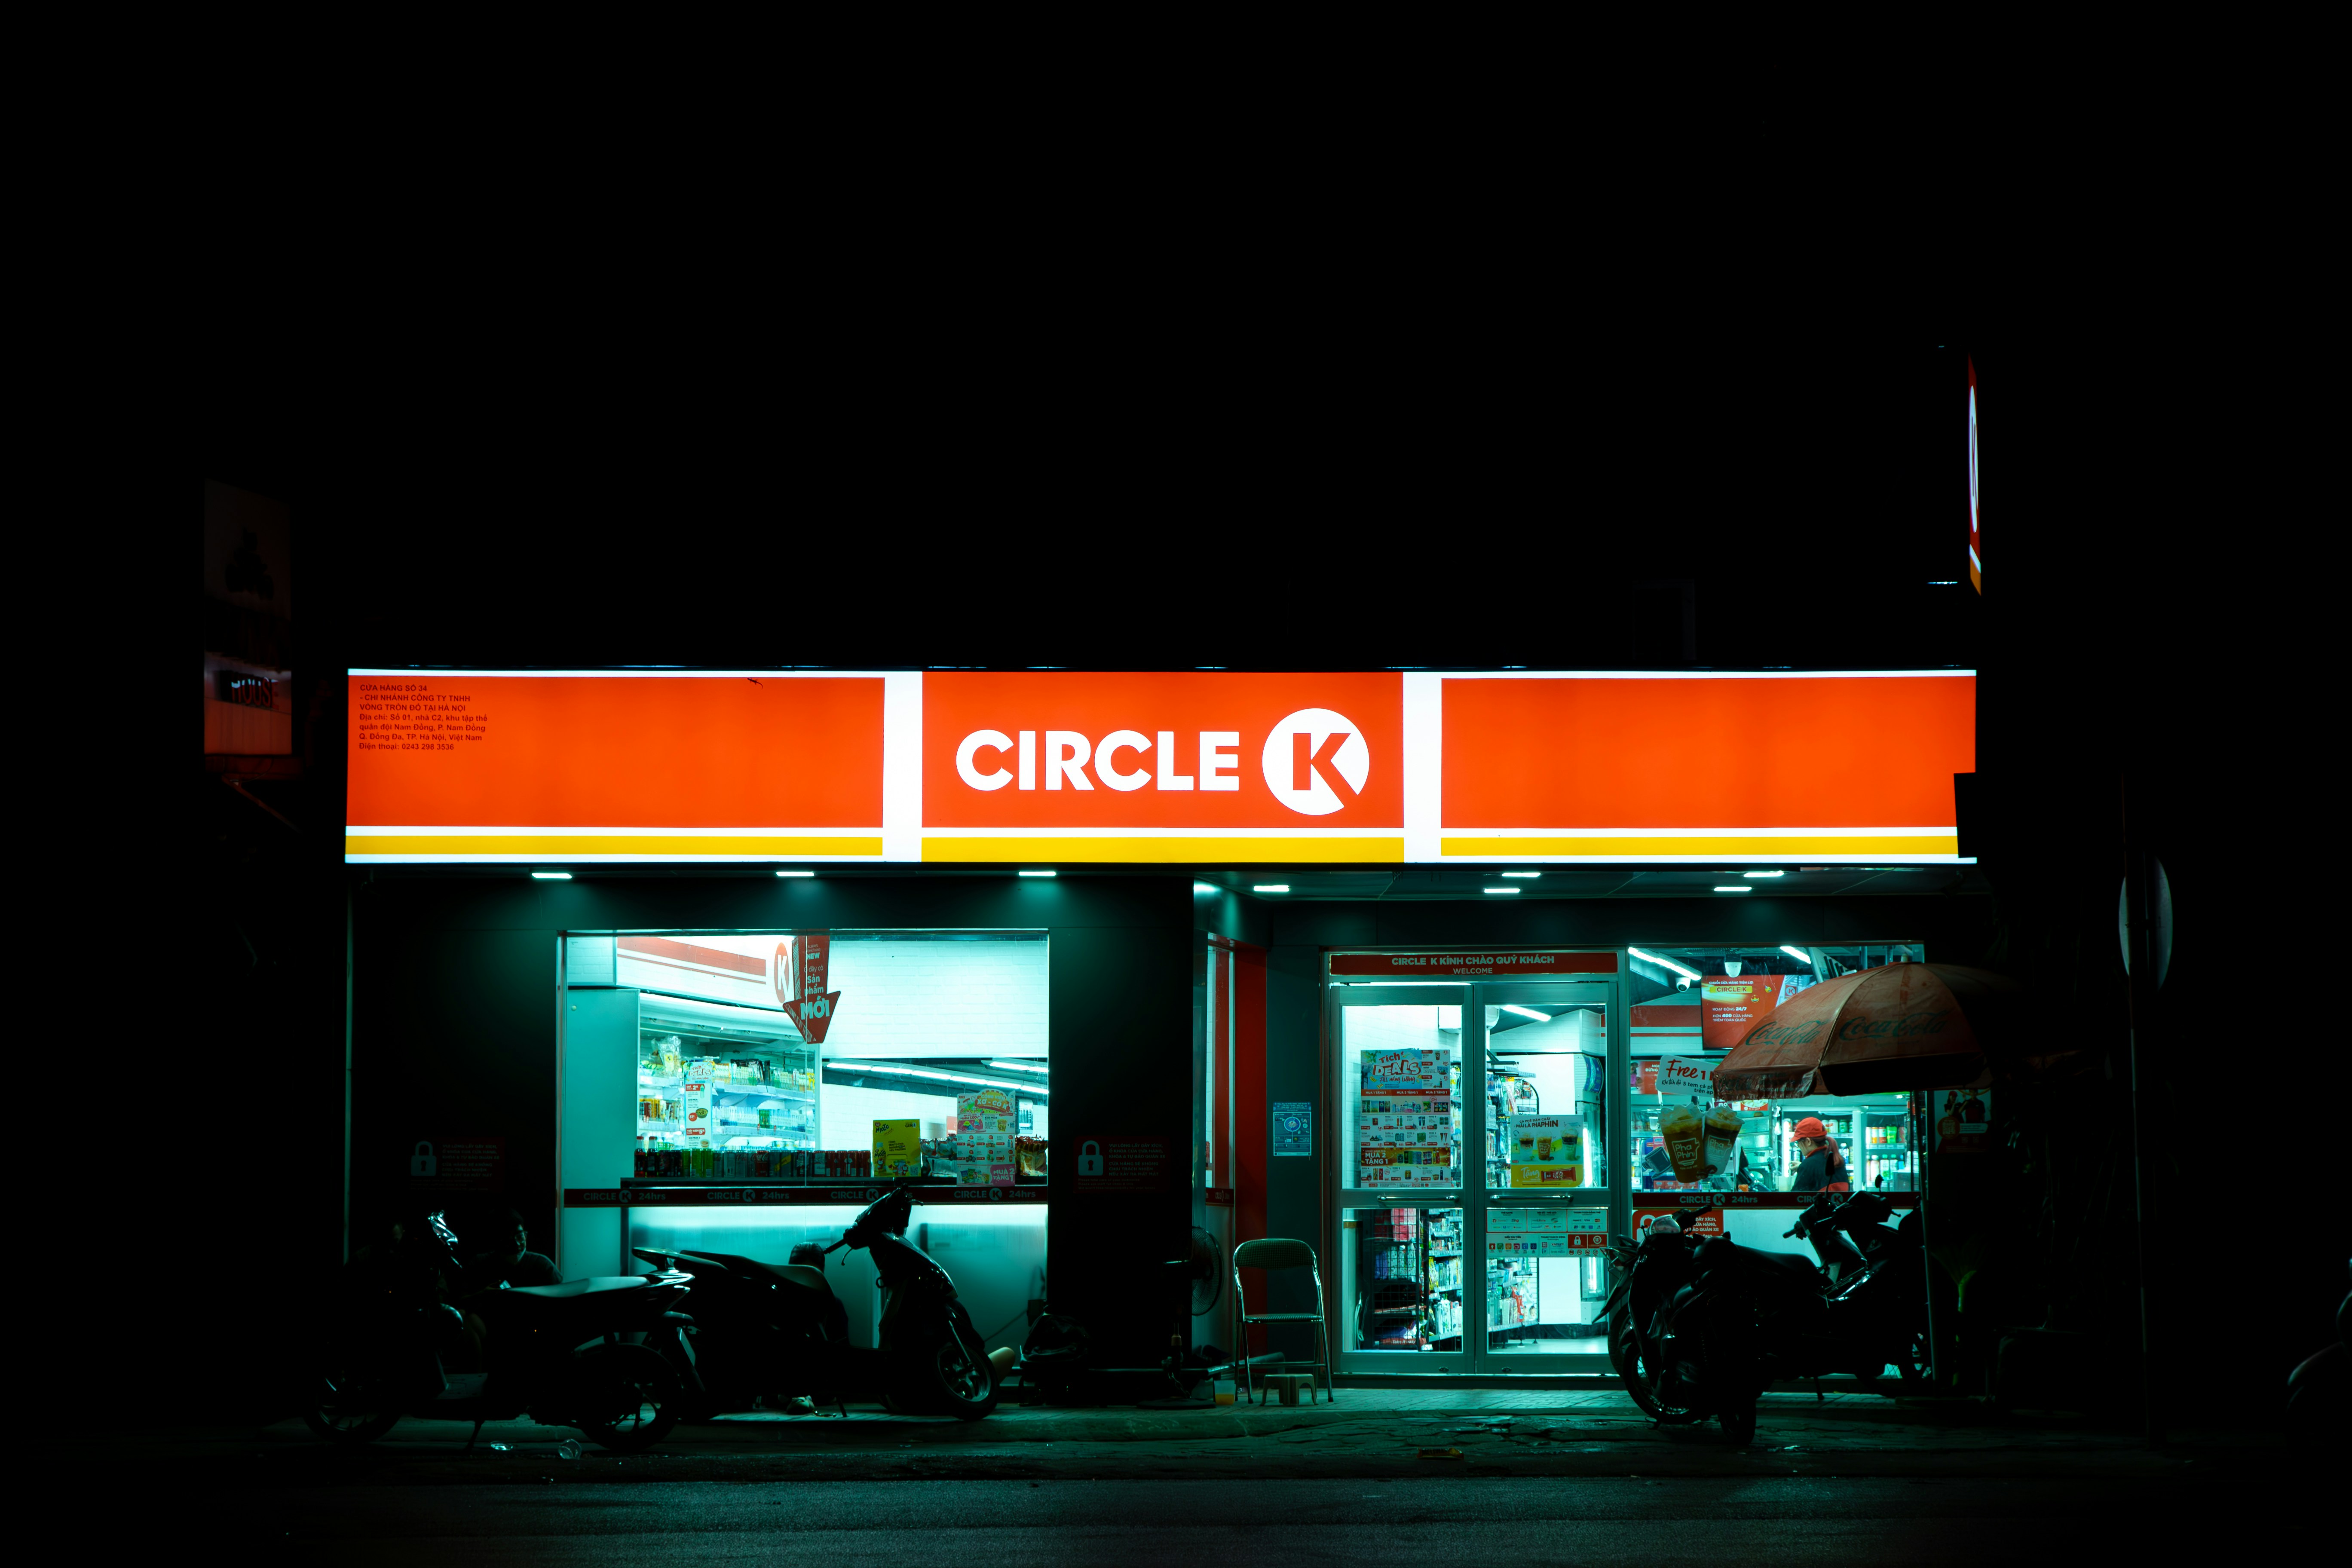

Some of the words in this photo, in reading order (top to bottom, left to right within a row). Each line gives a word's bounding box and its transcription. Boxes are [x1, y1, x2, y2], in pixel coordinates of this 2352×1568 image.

[956, 729, 1239, 791] CIRCLE
[1392, 957, 1426, 965] CIRCLE
[1439, 955, 1463, 965] KÍNH
[1465, 955, 1494, 965] CHÀO
[1496, 954, 1518, 964] QUÝ
[1519, 954, 1555, 964] KHÁCH
[807, 974, 820, 983] Sản
[800, 995, 830, 1020] MỚI
[1373, 1060, 1421, 1076] DEALS
[1666, 1059, 1698, 1078] Free
[1701, 1070, 1706, 1080] 1
[876, 1124, 889, 1133] MALTO
[1710, 1139, 1724, 1148] Pha
[1677, 1151, 1694, 1159] Phin
[583, 1192, 616, 1201] CIRCLE
[638, 1192, 666, 1200] 24hrs
[707, 1192, 740, 1200] CIRCLE
[762, 1191, 790, 1200] 24hrs
[830, 1191, 864, 1199] CIRCLE
[953, 1190, 987, 1198] CIRCLE
[1008, 1190, 1036, 1198] 24hrs
